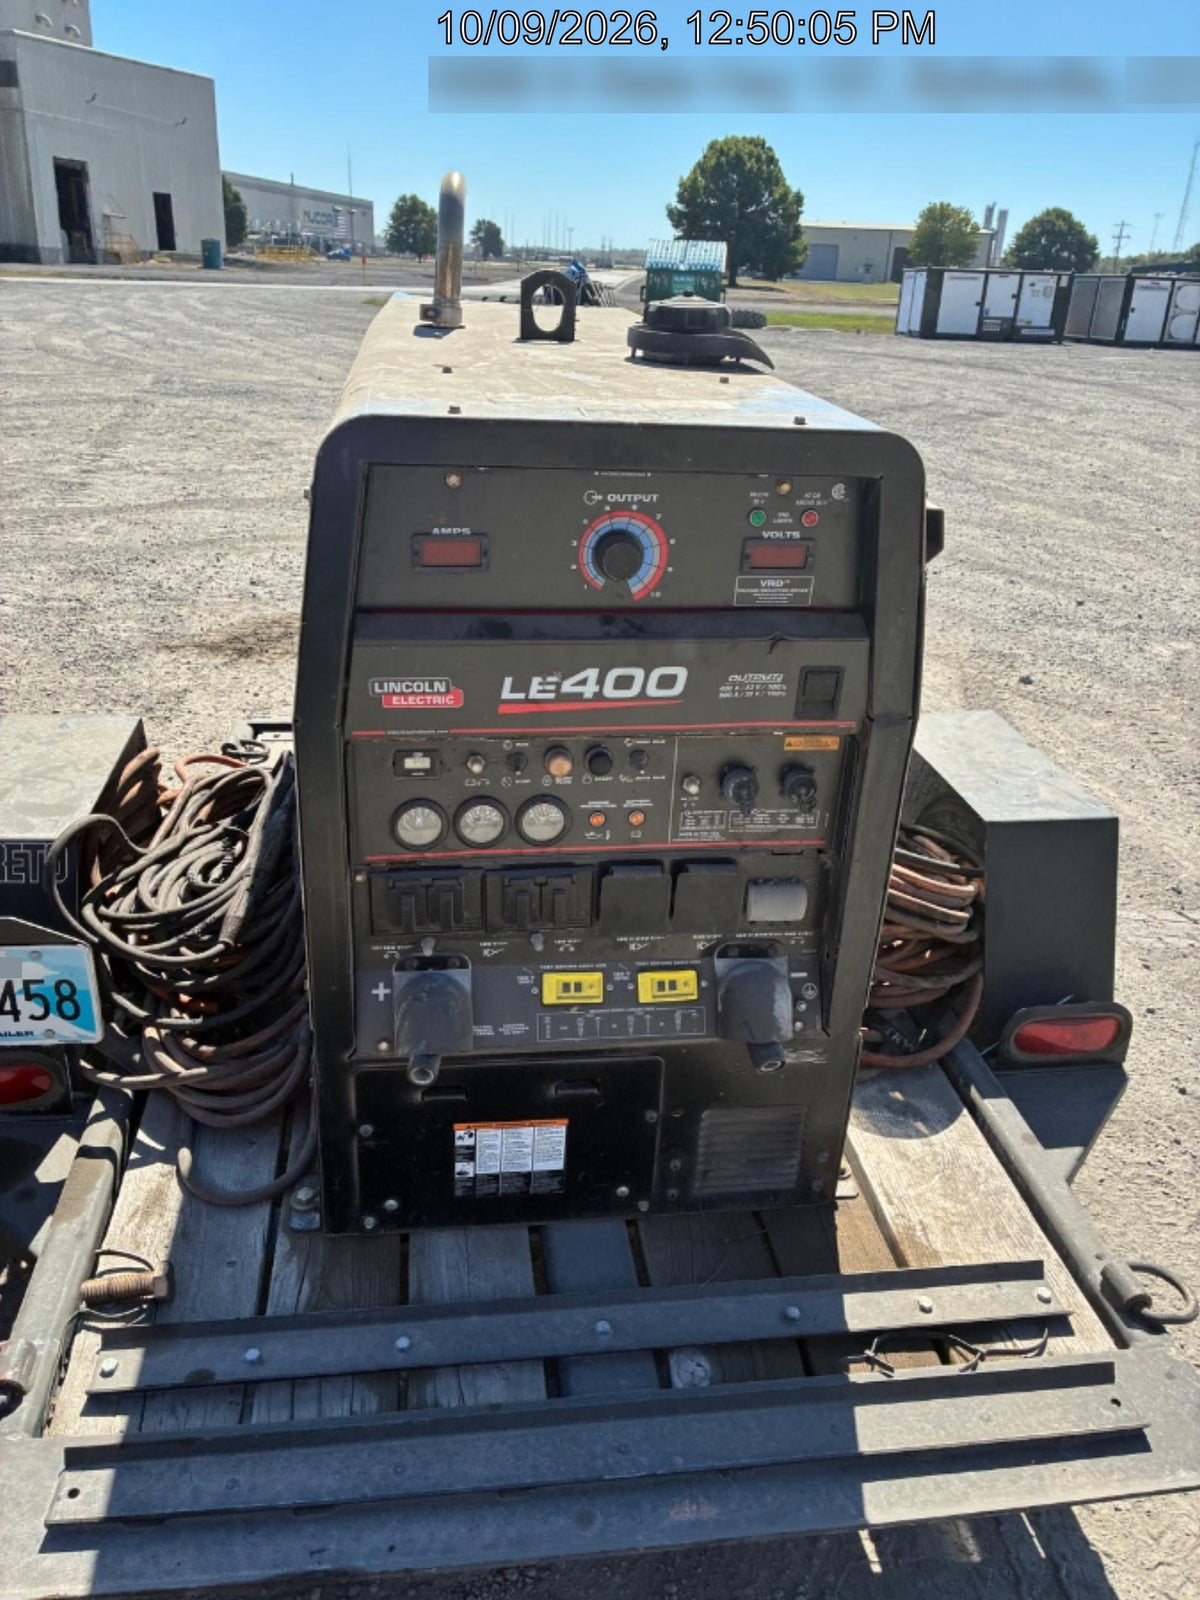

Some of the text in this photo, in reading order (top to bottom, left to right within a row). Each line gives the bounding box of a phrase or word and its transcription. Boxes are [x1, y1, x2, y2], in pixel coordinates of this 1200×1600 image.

[607, 494, 660, 503] OUTPUT
[431, 528, 471, 536] AMPS
[762, 531, 801, 540] VOLTS
[374, 681, 448, 694] LINCOLN
[500, 666, 688, 700] LE400
[391, 694, 455, 706] ELECTRIC
